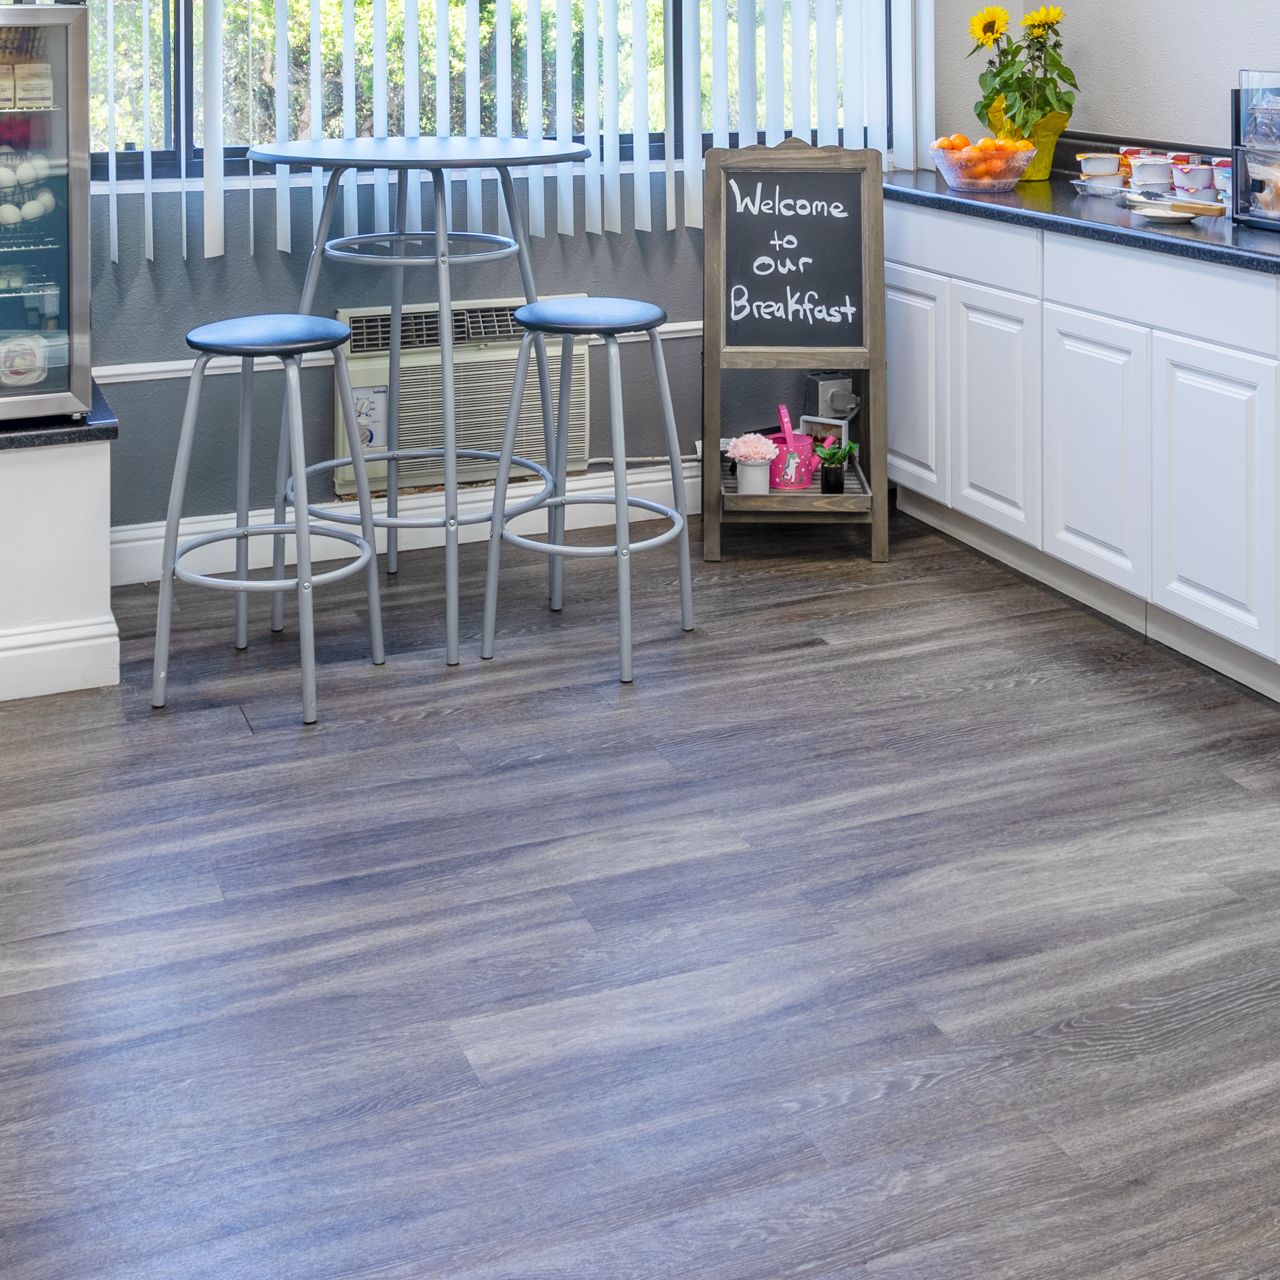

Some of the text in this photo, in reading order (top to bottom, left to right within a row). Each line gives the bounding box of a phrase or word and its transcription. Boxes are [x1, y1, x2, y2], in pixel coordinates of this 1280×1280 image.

[728, 178, 849, 218] Welcome
[770, 230, 798, 252] to
[753, 256, 813, 276] our
[730, 284, 856, 325] Breakfast
